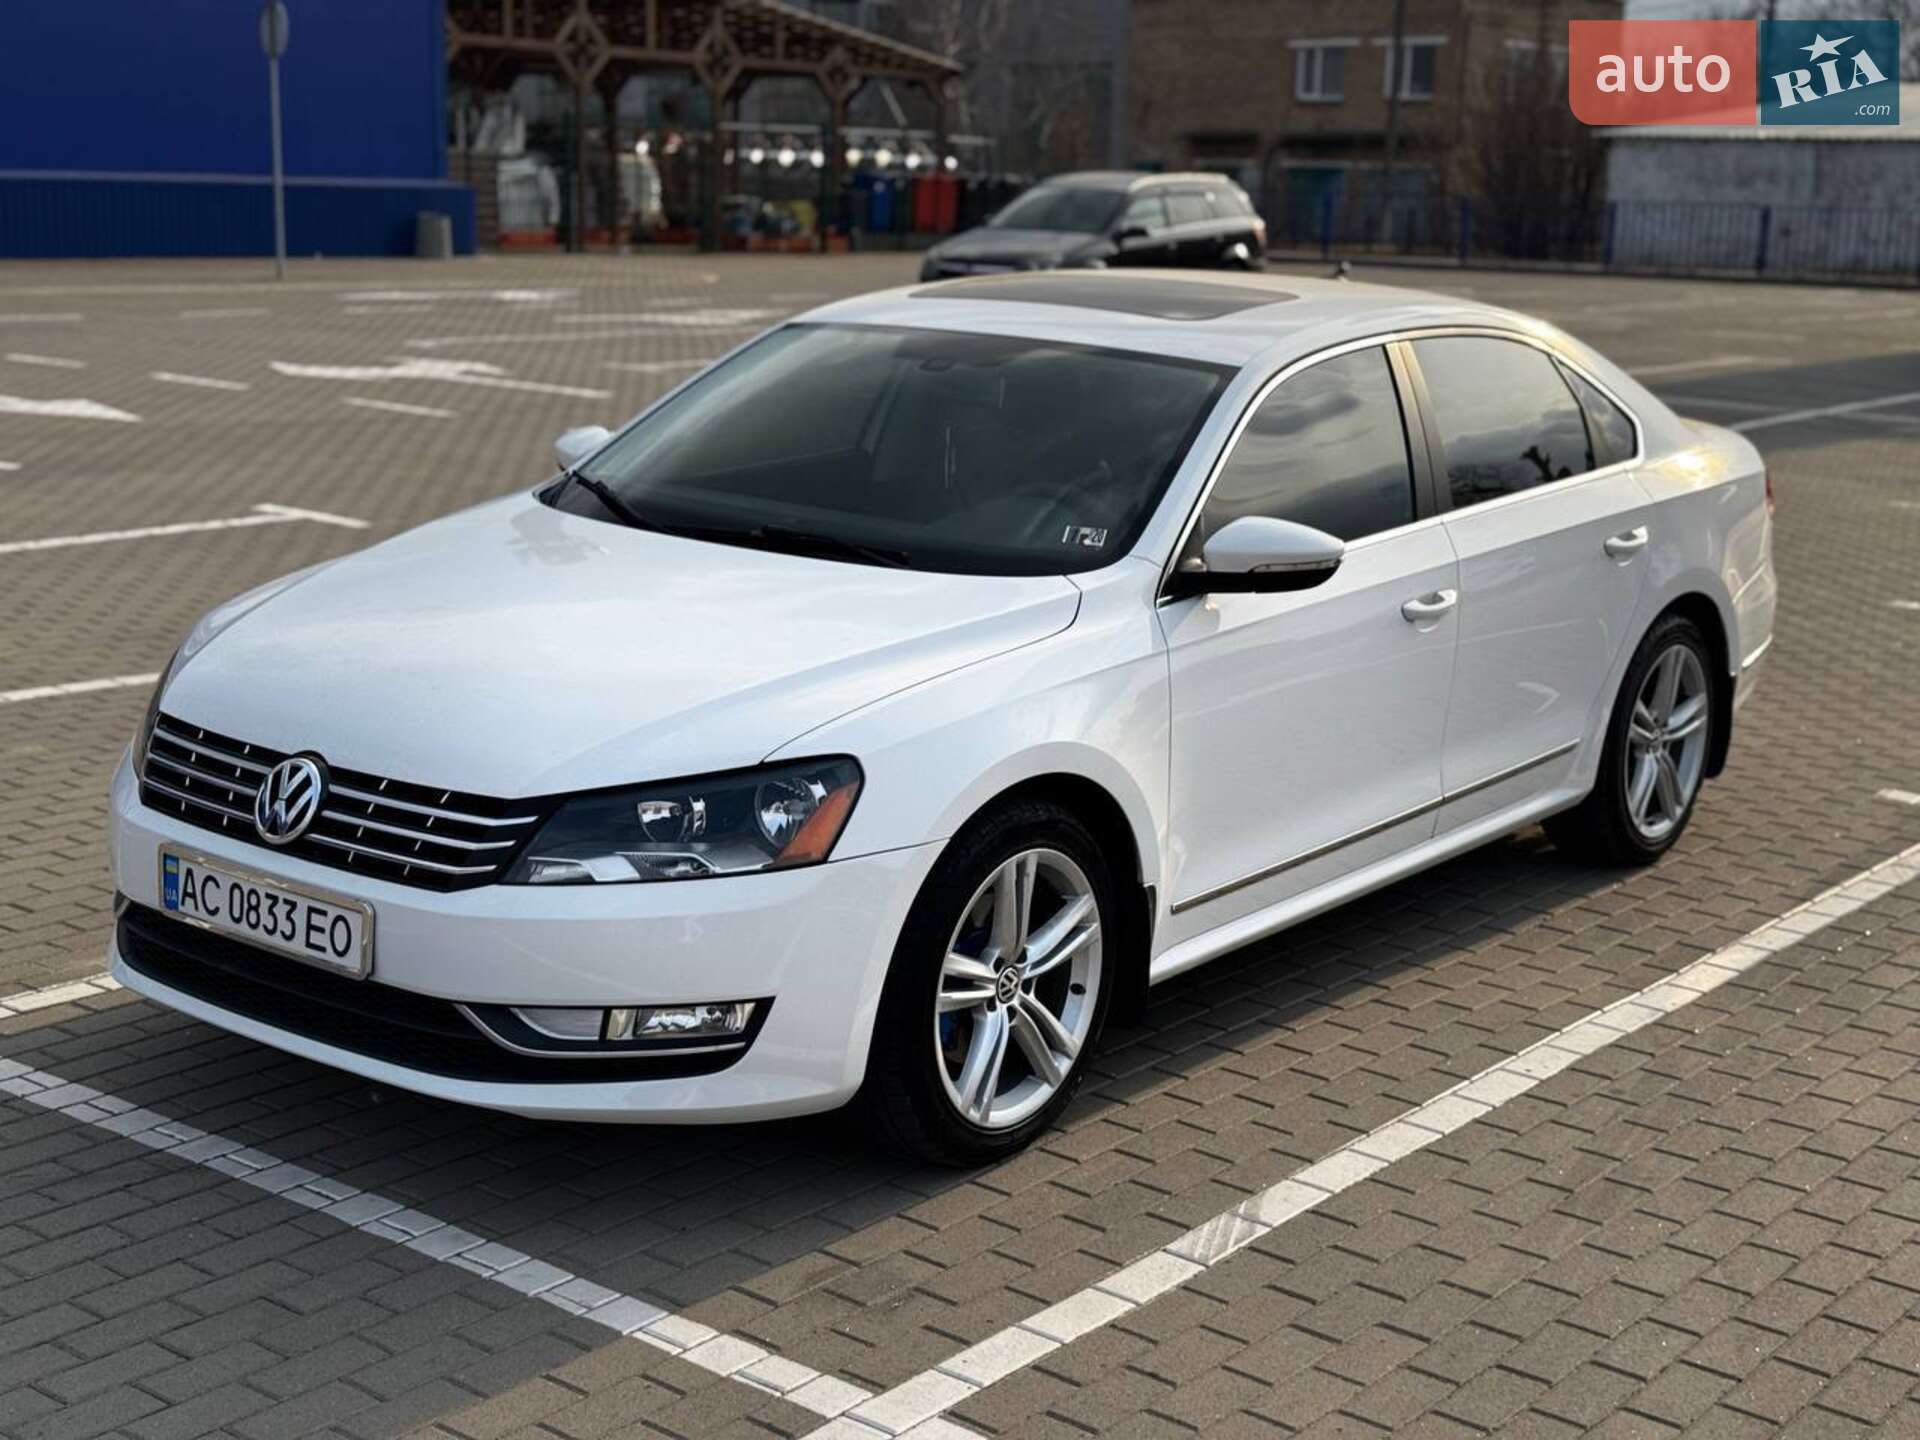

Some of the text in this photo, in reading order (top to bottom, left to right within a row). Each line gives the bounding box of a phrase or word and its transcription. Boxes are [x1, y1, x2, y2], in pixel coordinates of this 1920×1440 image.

[181, 867, 352, 957] AC 0833 EO
